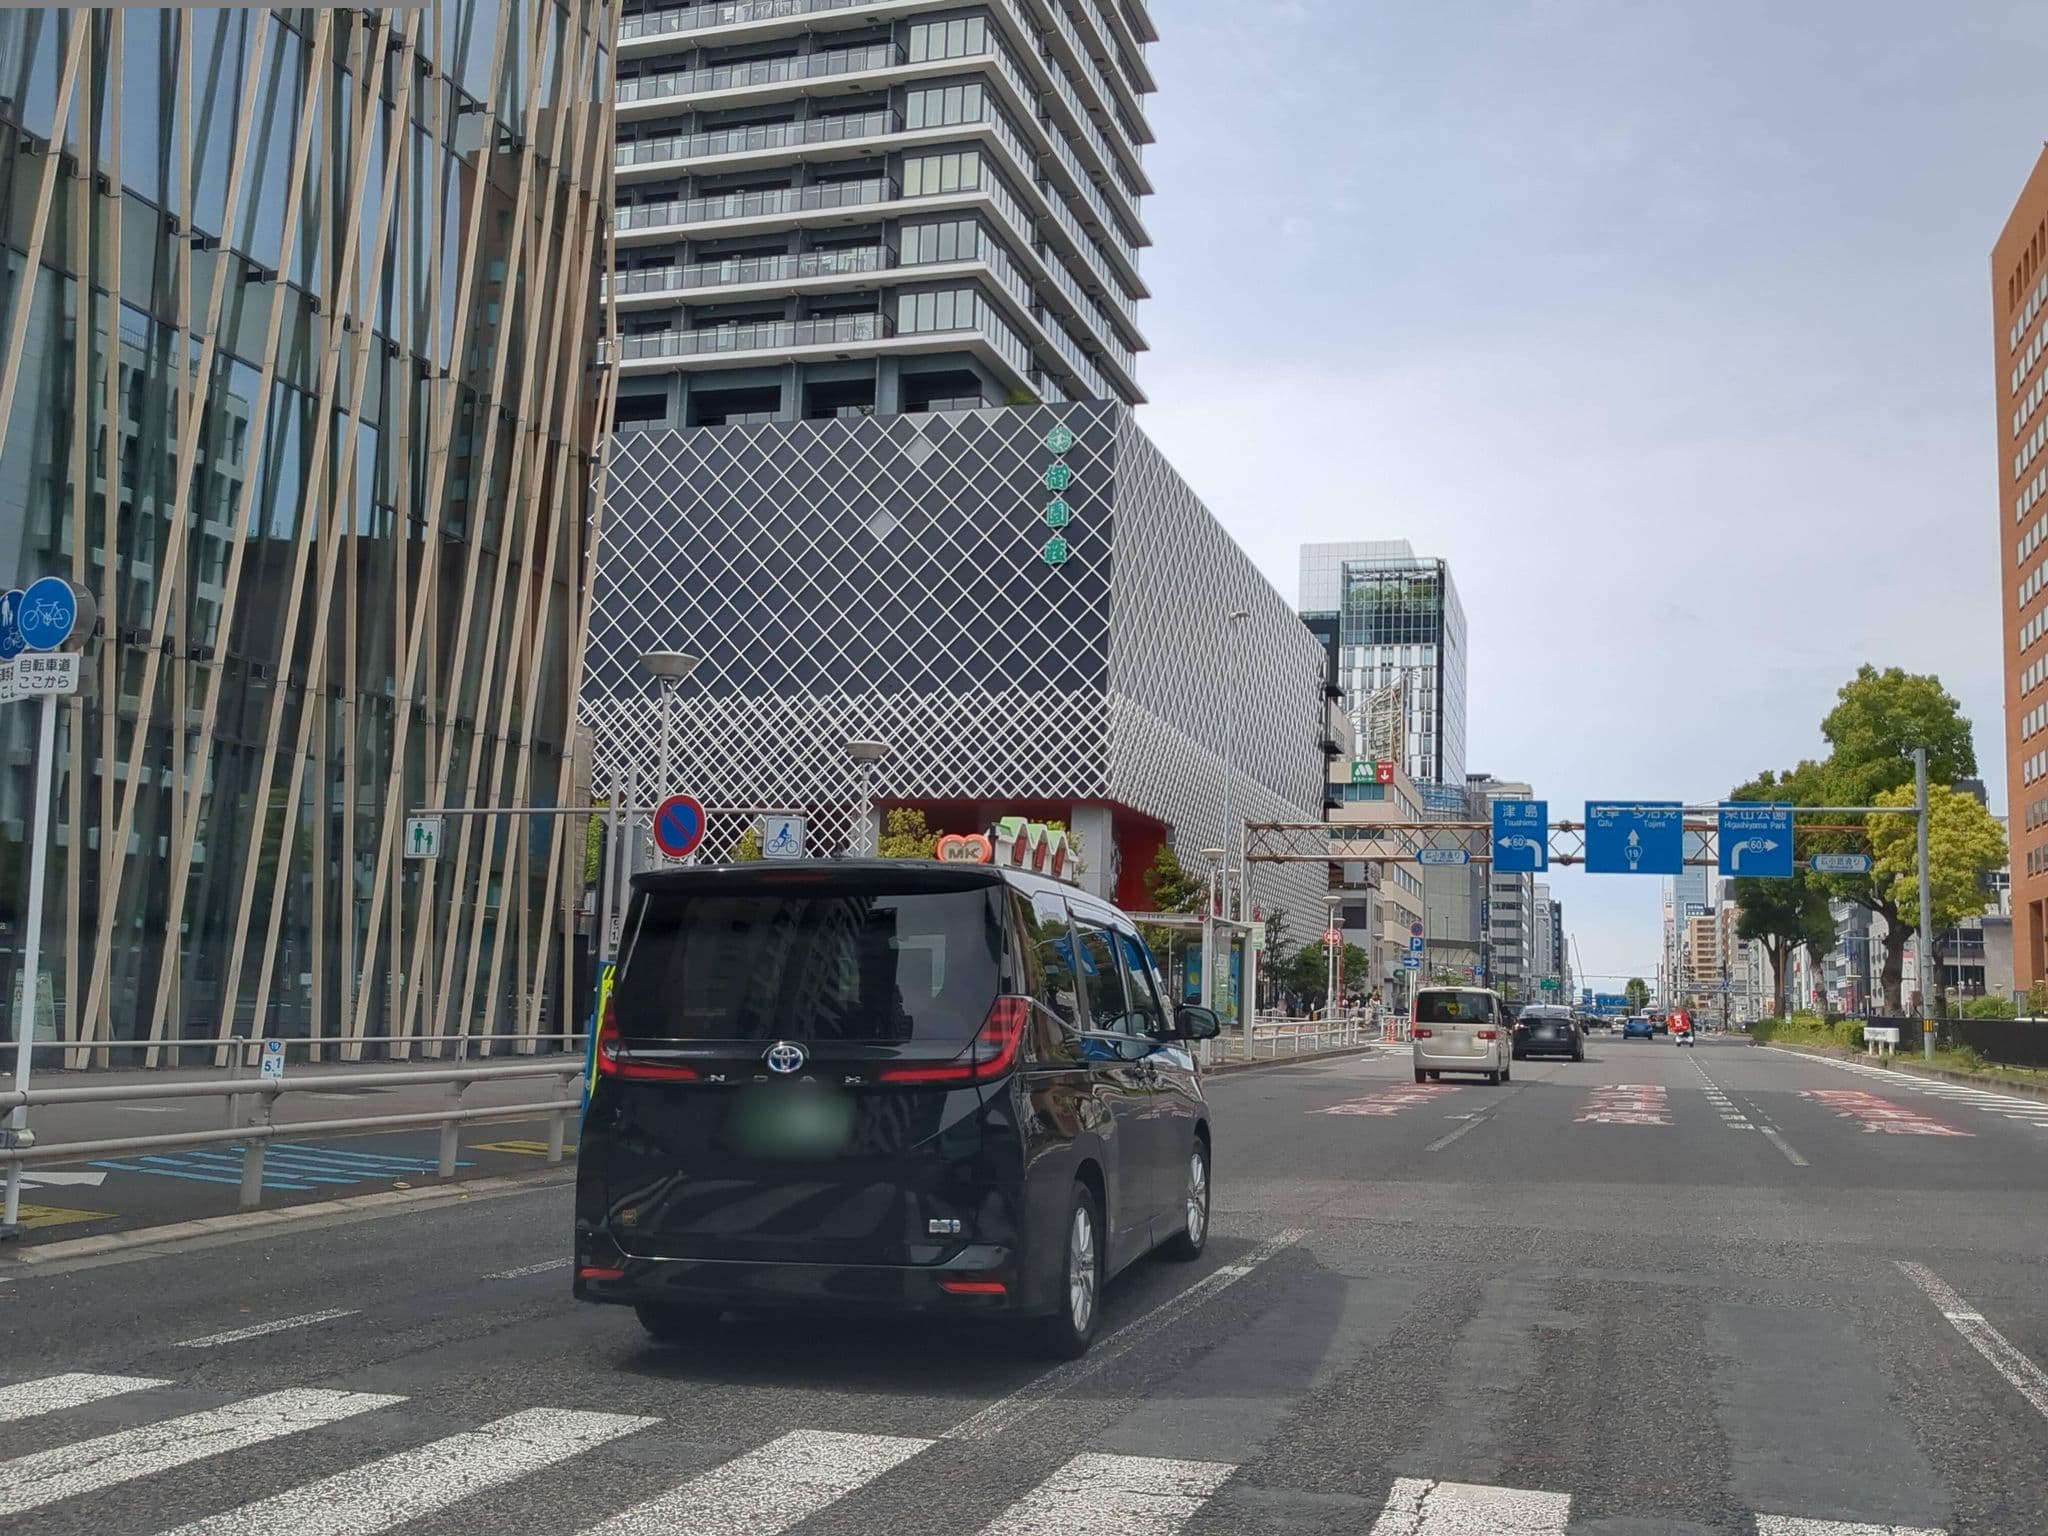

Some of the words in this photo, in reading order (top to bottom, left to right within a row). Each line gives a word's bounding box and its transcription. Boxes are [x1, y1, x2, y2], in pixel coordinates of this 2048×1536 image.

[19, 659, 71, 673] 自転車道
[18, 676, 70, 689] ここから
[1502, 804, 1538, 818] 津島
[1503, 818, 1538, 827] Tsushima
[1597, 818, 1613, 828] Gifu
[1643, 819, 1666, 830] Tajimi
[1724, 821, 1768, 831] Higashiyama
[1769, 821, 1787, 831] Park
[1512, 838, 1524, 847] 60
[1750, 840, 1763, 850] 60
[948, 848, 980, 860] MK
[1628, 848, 1639, 858] 19
